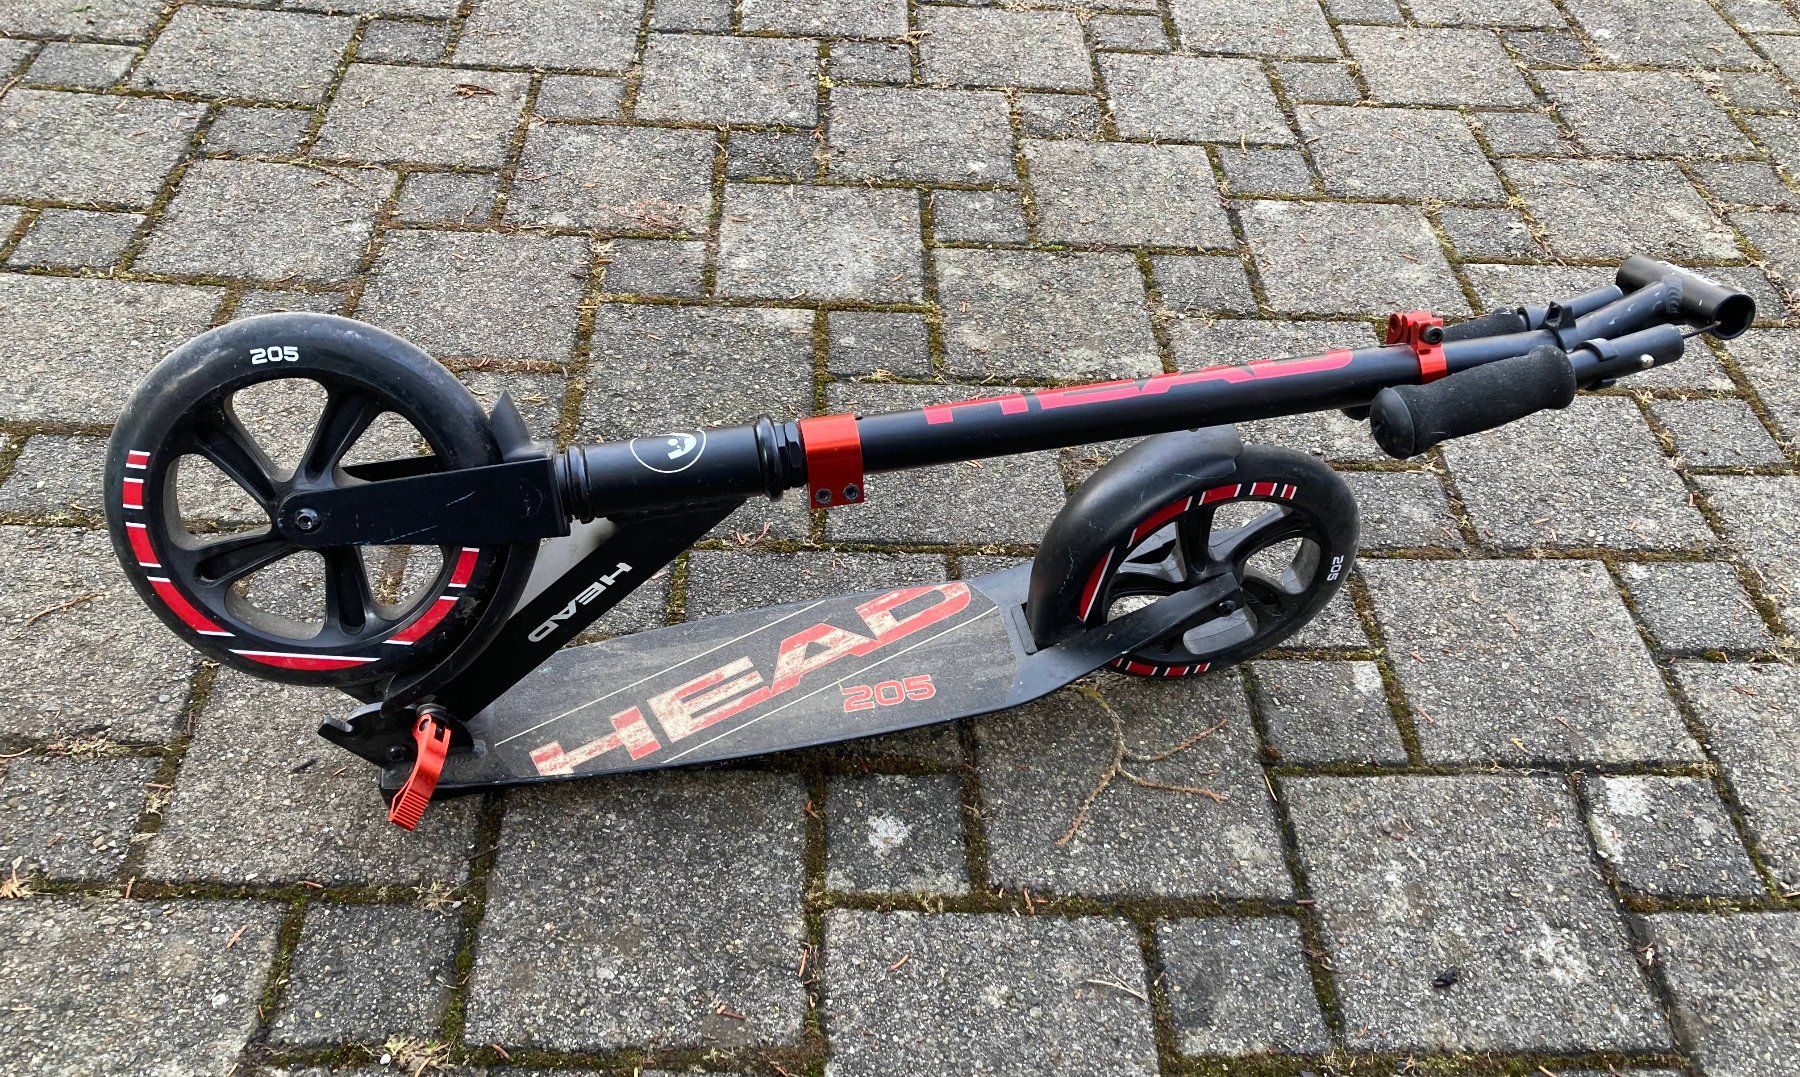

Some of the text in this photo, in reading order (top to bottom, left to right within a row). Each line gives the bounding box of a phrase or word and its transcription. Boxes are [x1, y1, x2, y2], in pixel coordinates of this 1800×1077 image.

[249, 345, 300, 365] 205
[1326, 554, 1345, 581] 205
[527, 562, 633, 643] HEAD
[529, 581, 972, 776] HEAD
[841, 674, 936, 713] 205
